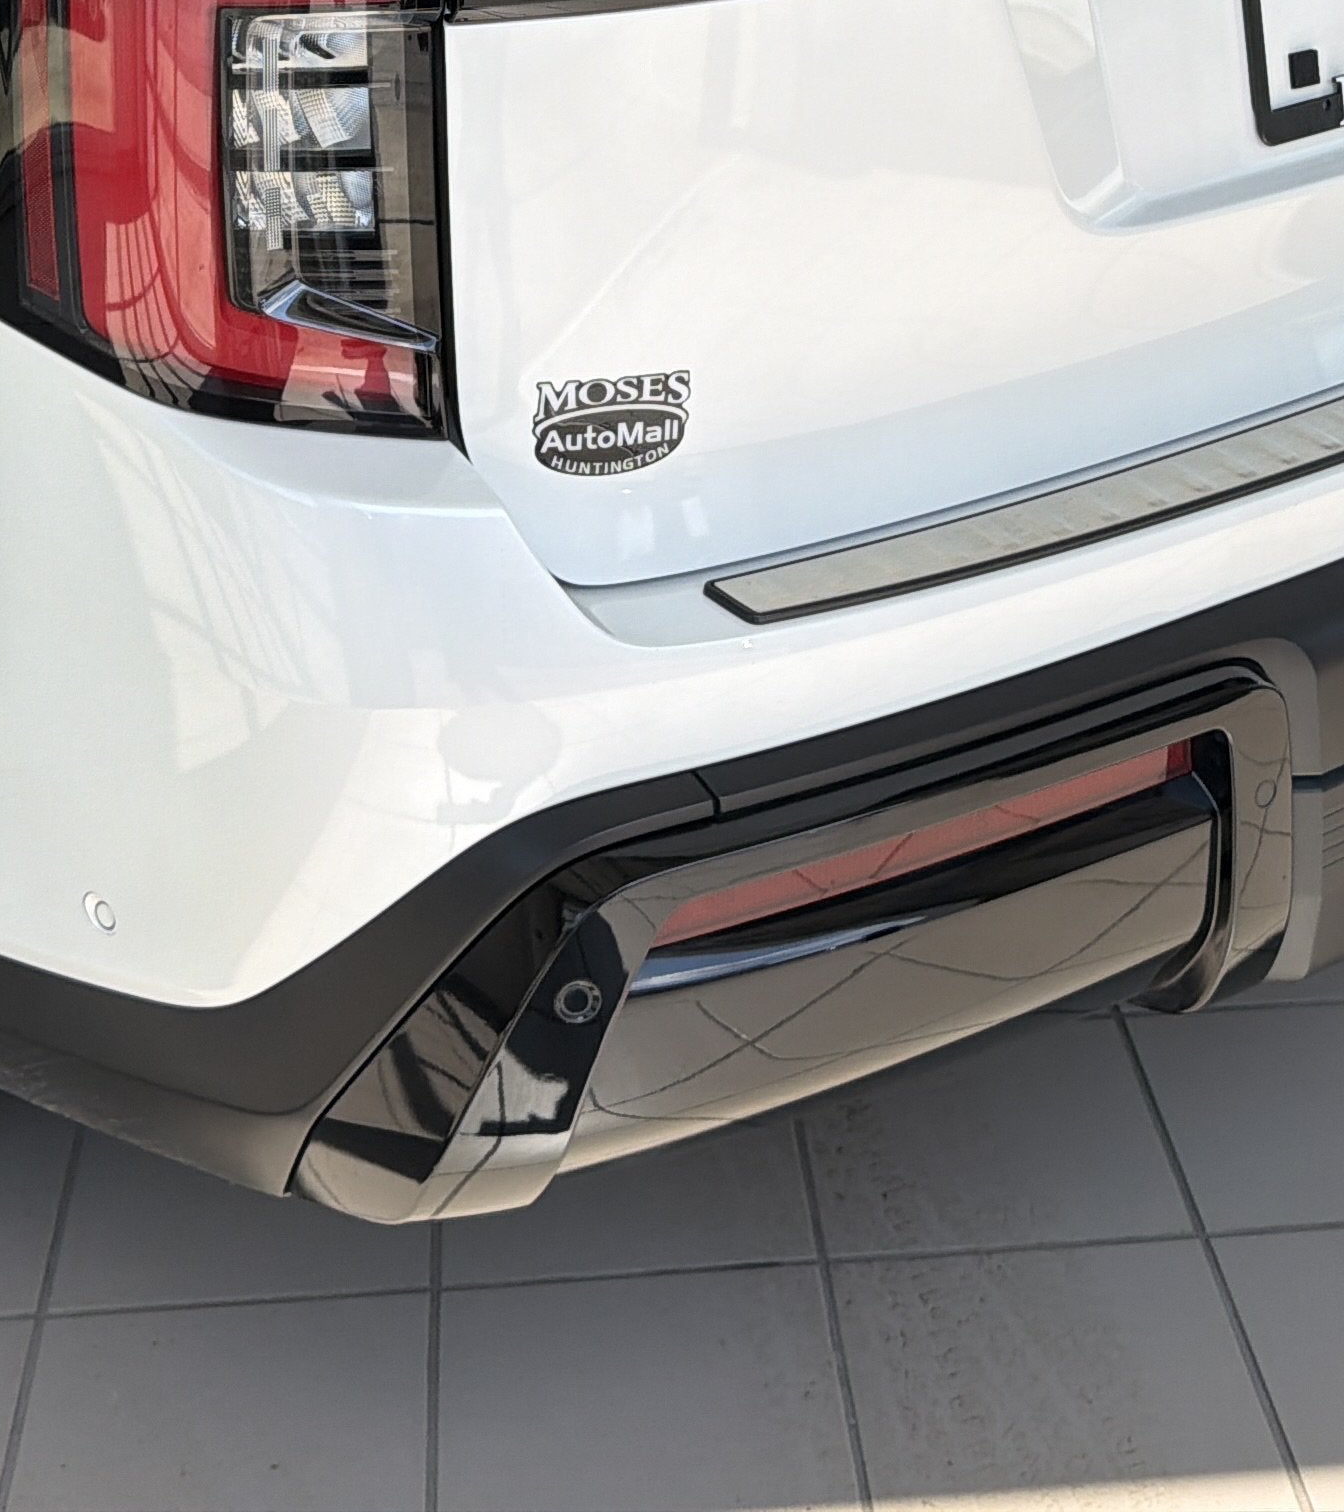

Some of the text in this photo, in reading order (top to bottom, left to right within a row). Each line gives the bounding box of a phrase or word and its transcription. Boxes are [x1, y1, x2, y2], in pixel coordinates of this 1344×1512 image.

[533, 369, 692, 423] MOSES
[540, 418, 679, 454] AutoMall
[550, 442, 671, 475] HUNTINGTON
